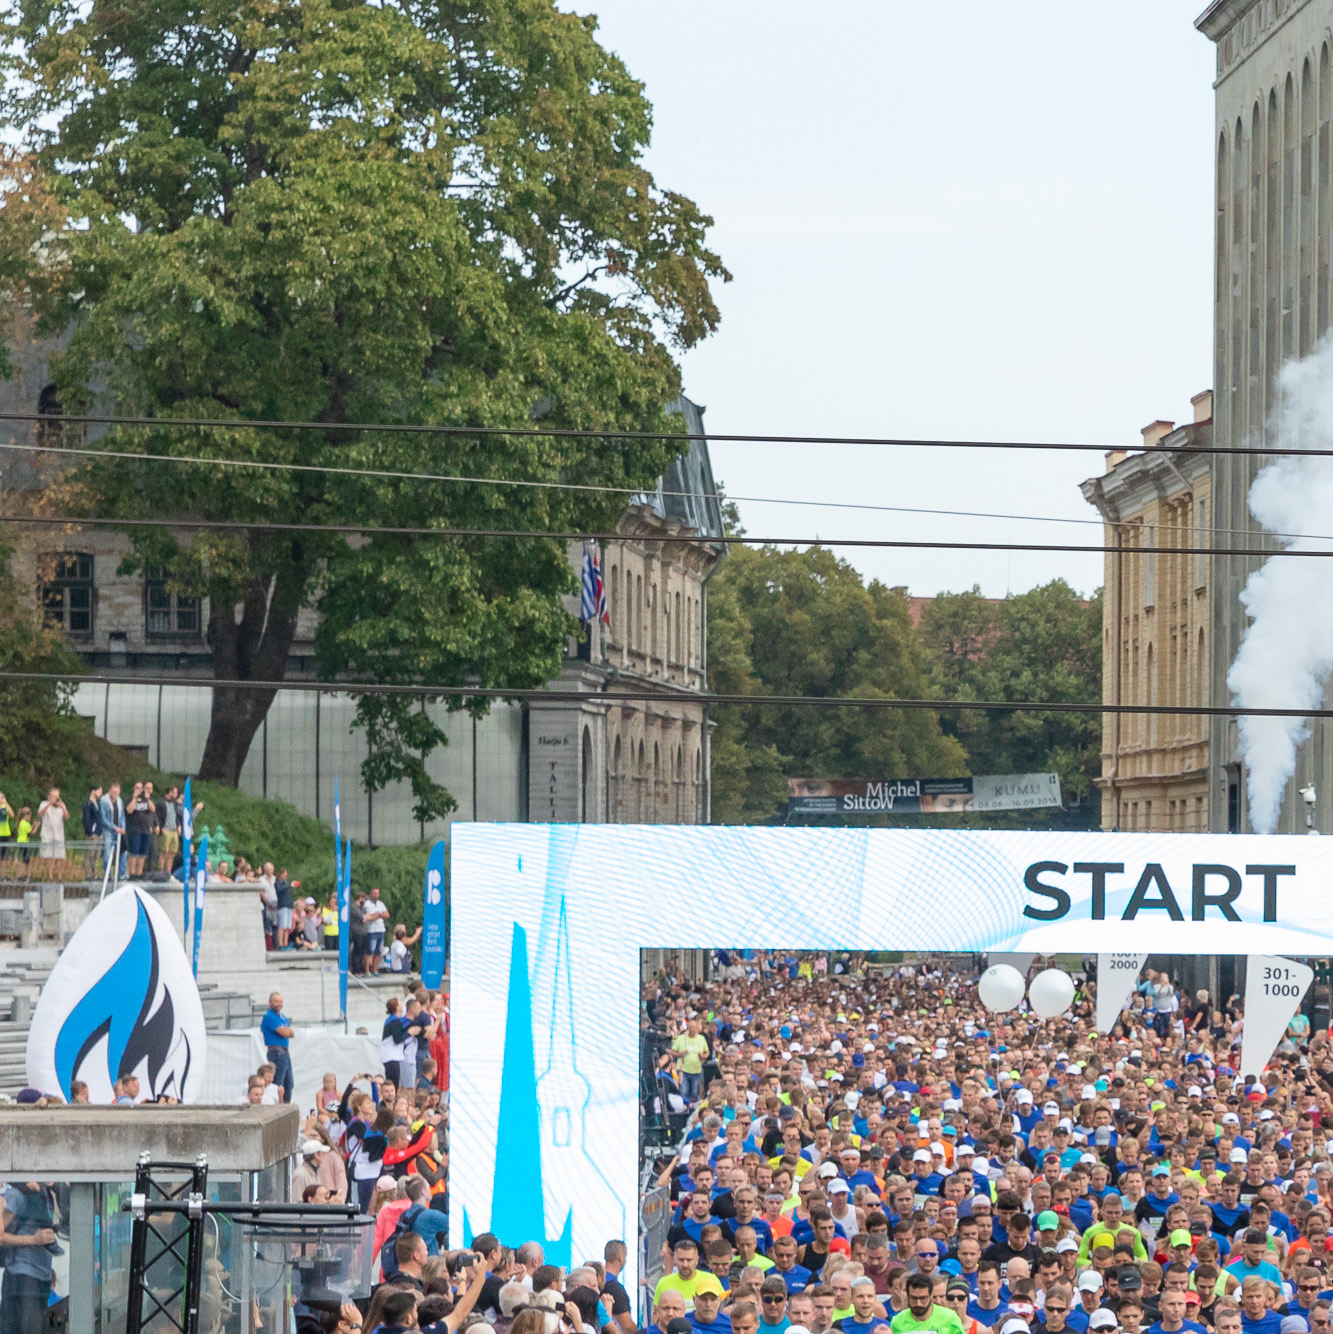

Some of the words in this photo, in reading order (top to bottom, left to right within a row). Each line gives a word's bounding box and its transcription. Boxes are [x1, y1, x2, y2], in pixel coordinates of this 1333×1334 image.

[867, 780, 920, 798] Michel
[994, 784, 1040, 797] KUMU
[1023, 860, 1296, 922] START
[1110, 960, 1138, 970] 2000
[1264, 967, 1297, 981] 301-
[1264, 983, 1300, 997] 1000
